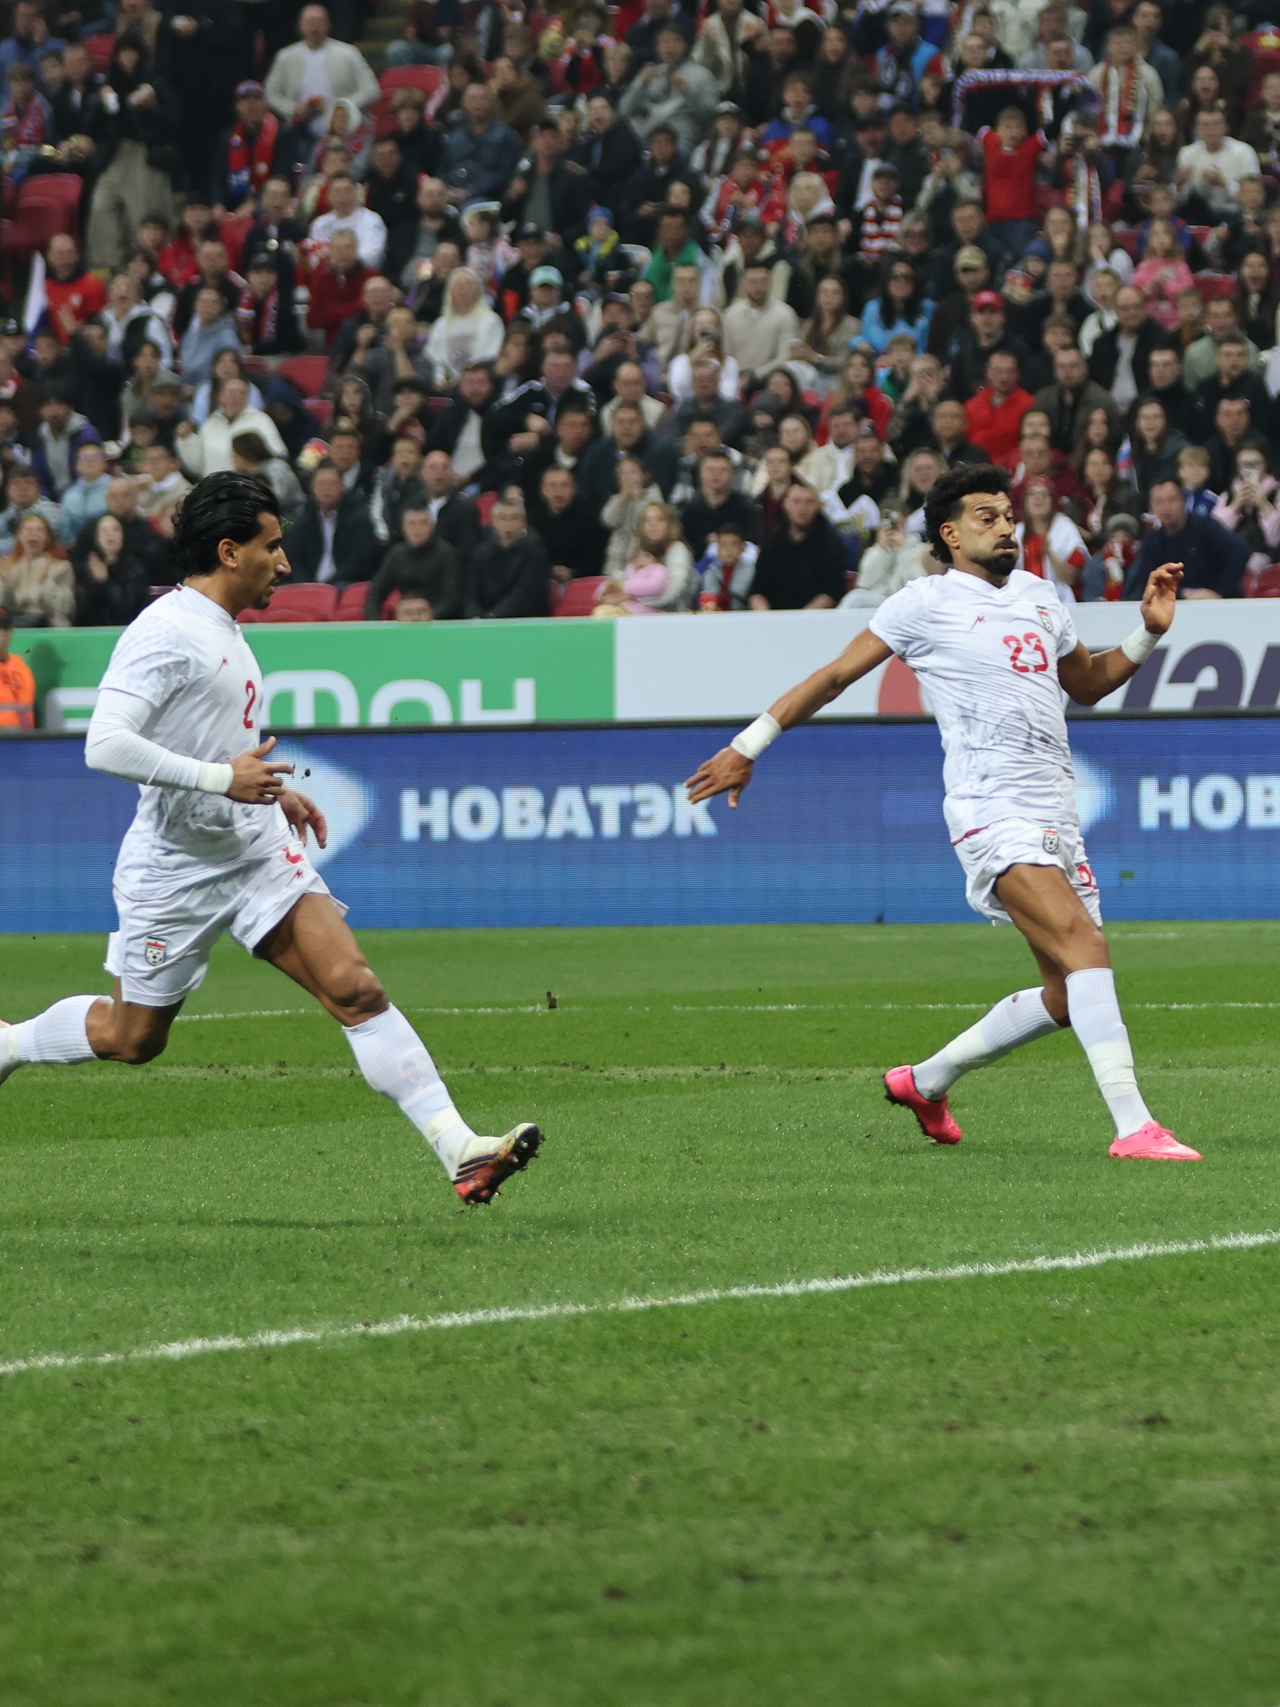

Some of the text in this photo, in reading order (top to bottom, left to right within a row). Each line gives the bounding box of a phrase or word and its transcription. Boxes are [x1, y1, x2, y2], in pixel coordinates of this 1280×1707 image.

[1002, 632, 1048, 673] 23
[243, 679, 256, 729] 2
[400, 783, 718, 842] НОВАТЭК
